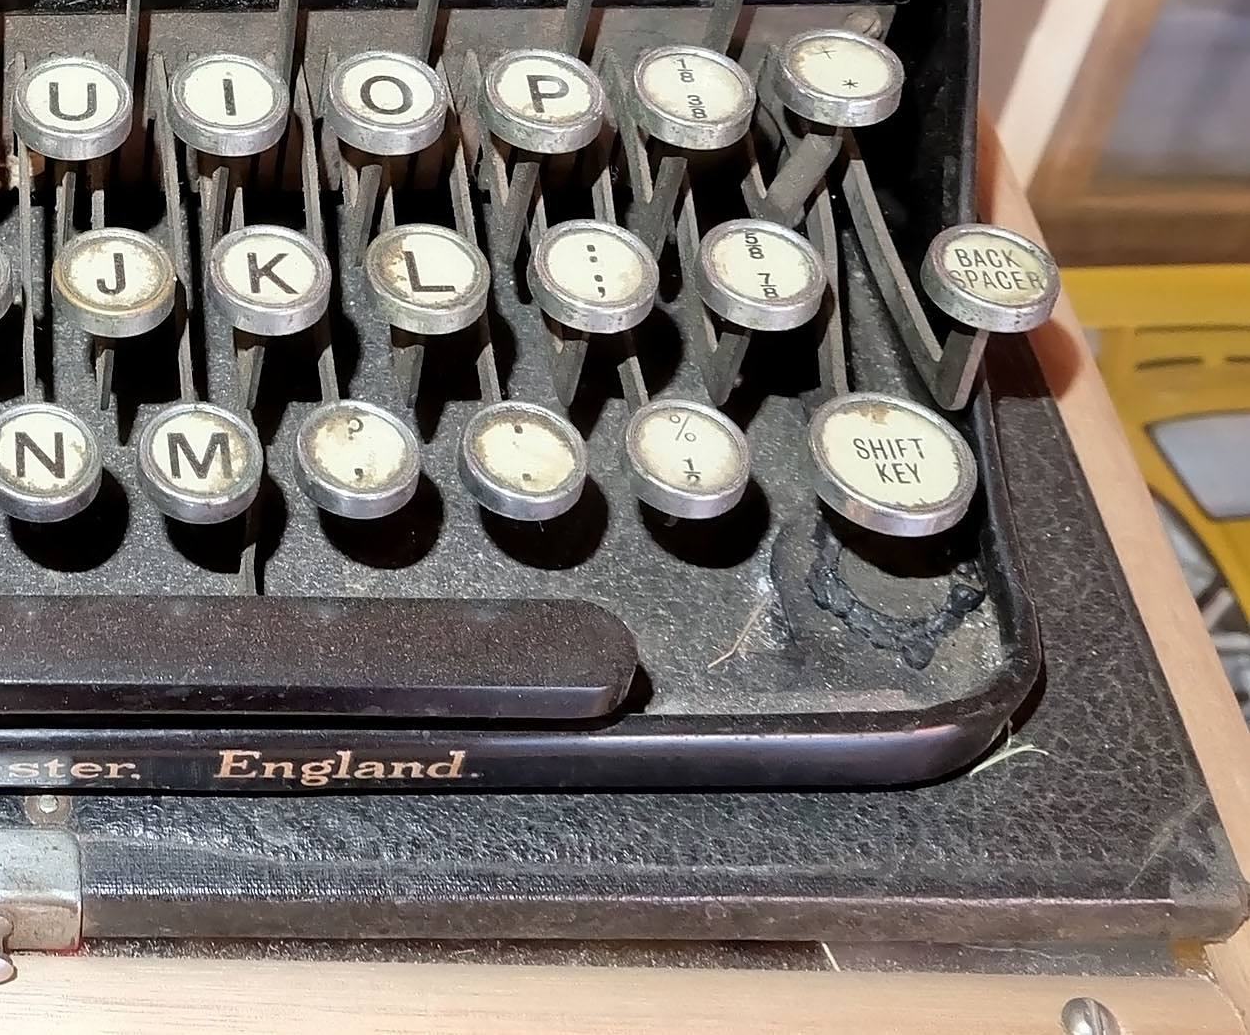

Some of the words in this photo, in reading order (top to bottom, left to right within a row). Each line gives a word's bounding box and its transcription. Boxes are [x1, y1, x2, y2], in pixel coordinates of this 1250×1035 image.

[49, 82, 97, 121] U
[222, 78, 237, 116] I
[360, 76, 413, 115] O
[526, 75, 569, 113] P
[96, 252, 126, 295] J
[246, 252, 298, 294] K
[402, 250, 455, 293] L
[954, 248, 1022, 268] BACK
[949, 269, 1045, 291] SPACER
[670, 414, 697, 442] %
[15, 432, 66, 479] N
[166, 432, 233, 480] M
[853, 438, 926, 462] SHIFT
[875, 463, 921, 484] KEY
[213, 749, 479, 786] England.
